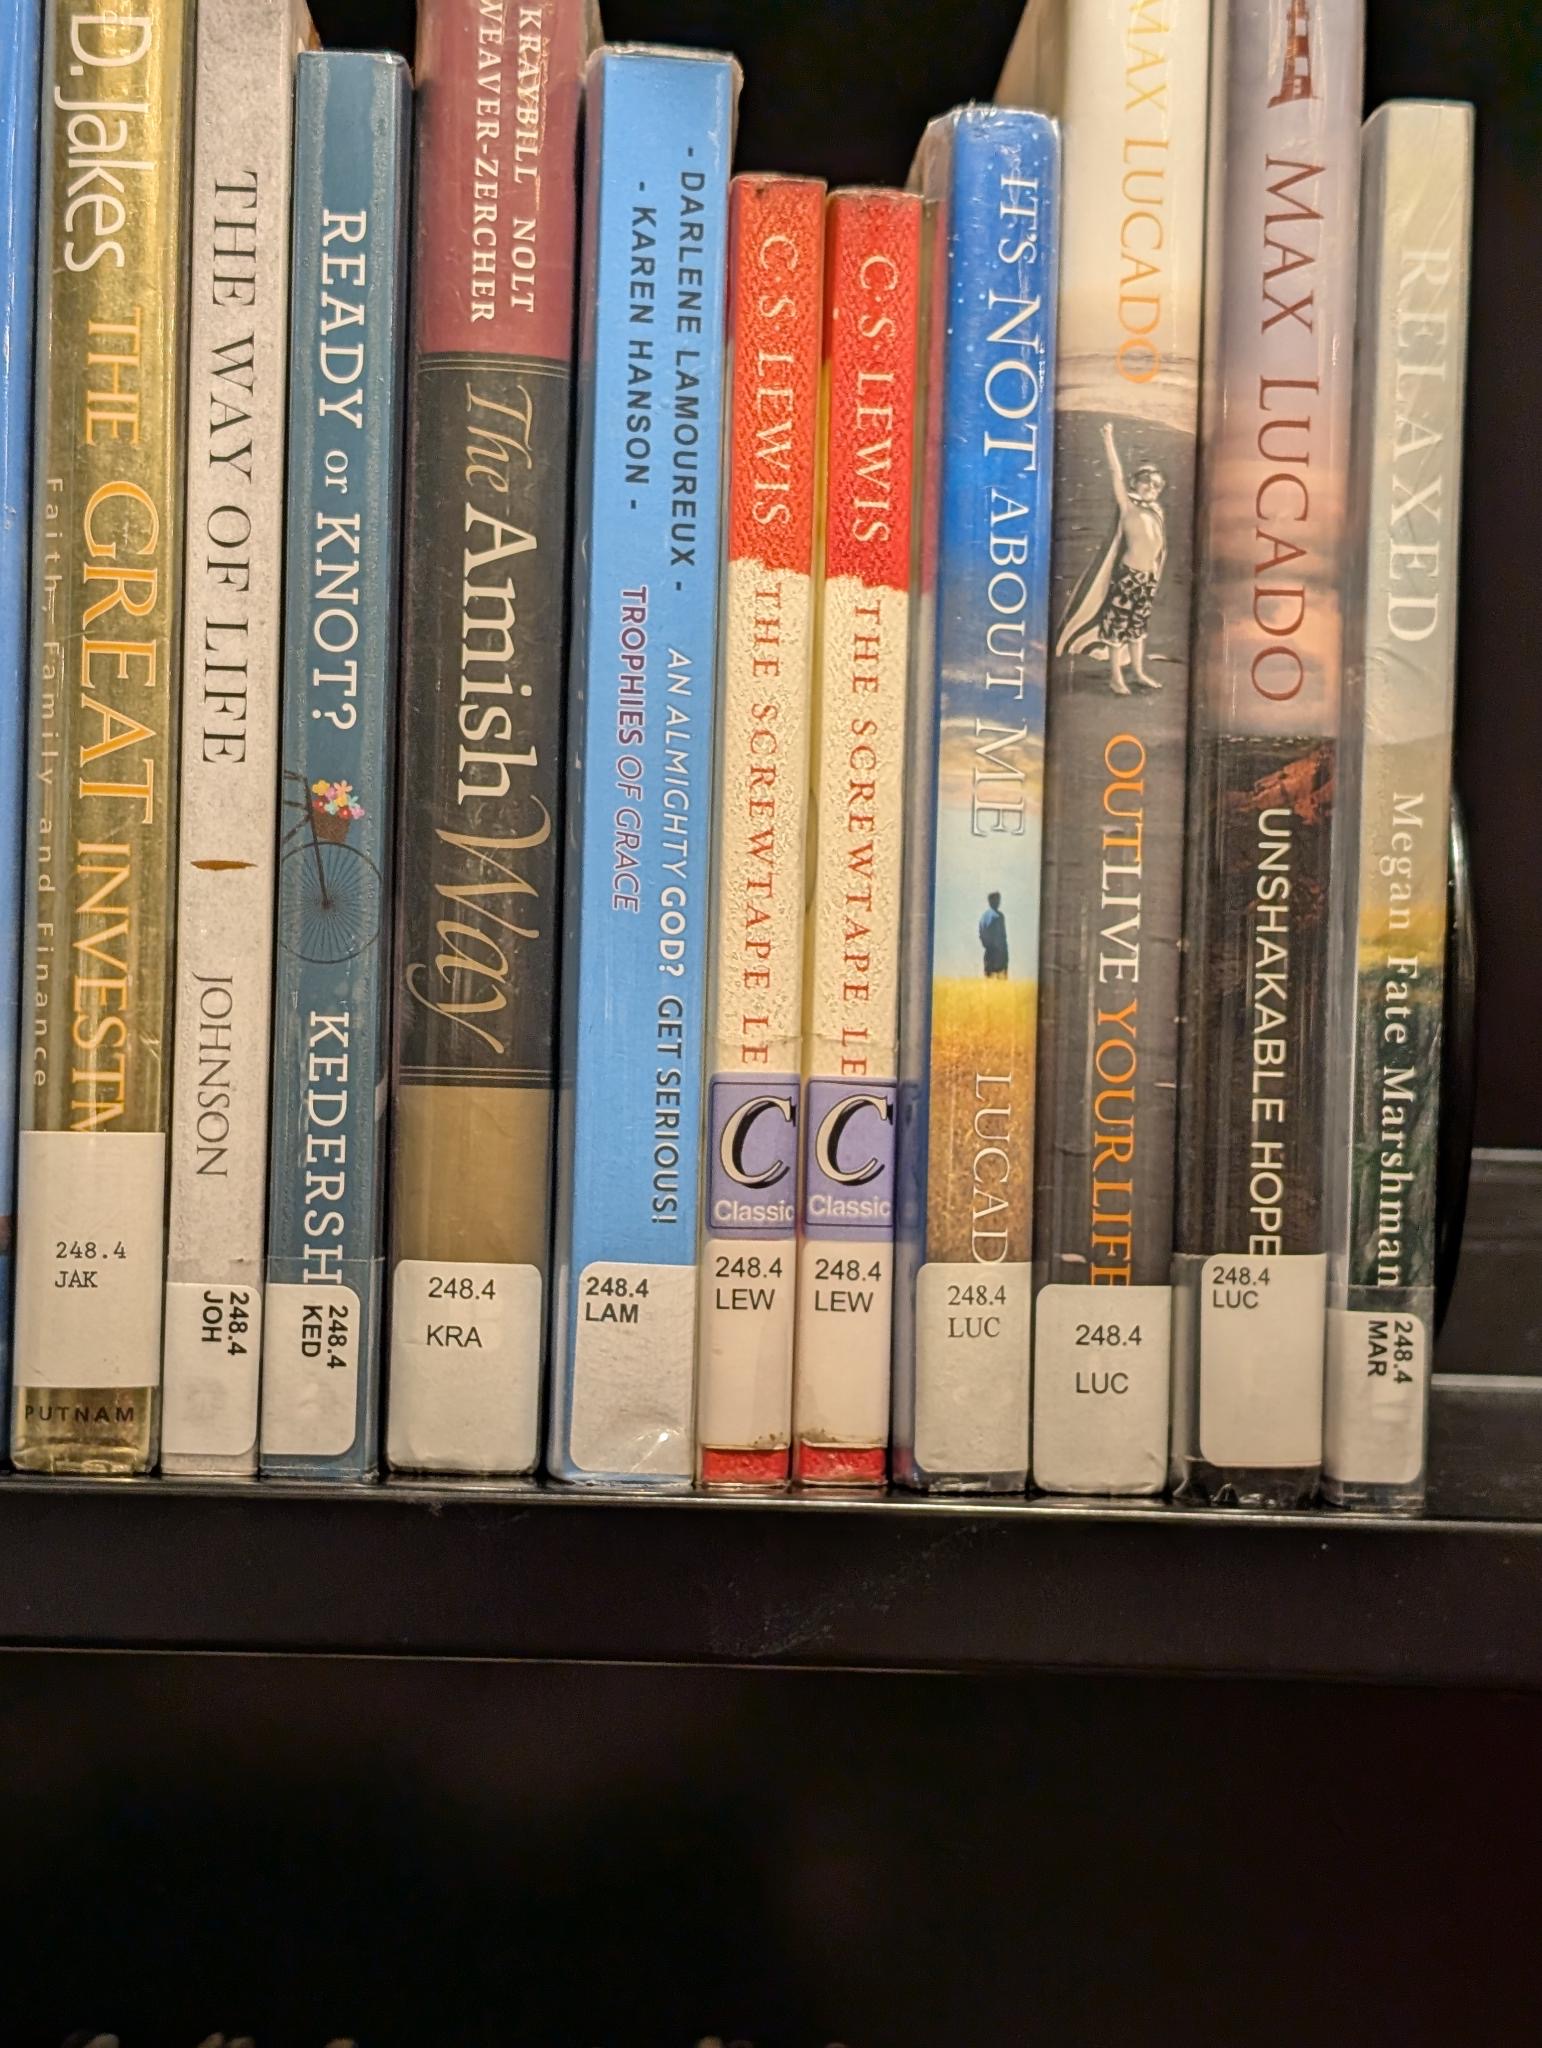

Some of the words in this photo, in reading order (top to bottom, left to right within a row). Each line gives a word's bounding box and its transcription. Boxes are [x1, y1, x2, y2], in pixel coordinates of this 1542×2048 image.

[70, 15, 152, 76] D.
[514, 8, 542, 184] KRAYBILL
[1124, 0, 1169, 112] MAX
[54, 86, 156, 273] Jakes
[471, 0, 504, 322] WEAVER-ZERCHER
[213, 170, 258, 306] THE
[510, 218, 537, 312] NOLT
[629, 208, 657, 324] KAREN
[675, 171, 705, 333] DARLENE
[1115, 137, 1170, 384] LUCADO
[1261, 154, 1327, 335] MAX
[319, 208, 367, 429] READY
[86, 307, 141, 446] THE
[209, 332, 254, 483] WAY
[625, 340, 654, 484] HANSON
[983, 289, 1041, 471] NOT
[324, 450, 349, 494] or
[465, 383, 533, 492] The
[671, 349, 703, 567] LAMOUREUX
[1385, 247, 1451, 642] RELAXED
[206, 505, 252, 592] OF
[1251, 375, 1320, 701] LUCADO
[312, 512, 361, 730] KNOT?
[752, 583, 783, 678] THE
[851, 600, 883, 694] THE
[986, 489, 1029, 700] ABOUT
[79, 481, 159, 825] GREAT
[202, 616, 249, 763] LIFE
[457, 502, 537, 805] Amish
[617, 586, 649, 746] TROPHIES
[666, 648, 692, 696] AN
[37, 642, 60, 786] Family
[616, 756, 644, 802] OF
[661, 705, 691, 879] ALMIGHTY
[972, 718, 1028, 837] ME
[38, 817, 56, 891] and
[612, 808, 642, 914] GRACE
[743, 702, 779, 990] SCREWTAPE
[841, 719, 877, 1003] SCREWTAPE
[1098, 733, 1147, 984] OUTLIVE
[1380, 792, 1424, 931] Megan
[406, 795, 551, 1054] Way
[658, 886, 686, 977] GOD?
[1251, 808, 1292, 1123] UNSHAKABLE
[33, 923, 55, 1086] Finance
[657, 997, 683, 1060] GET
[741, 1015, 771, 1065] LE
[841, 1027, 869, 1076] LE
[1384, 955, 1419, 1044] Fate
[192, 975, 233, 1178] JOHNSON
[1092, 1001, 1137, 1172] YOUR
[303, 1010, 350, 1285] KEDERSH
[652, 1069, 682, 1225] SERIOUS!
[720, 1095, 796, 1188] C
[815, 1093, 893, 1186] C
[971, 1072, 1013, 1264] LUCAD
[1377, 1067, 1418, 1288] Marshman
[55, 1241, 127, 1260] 248.4
[808, 1195, 891, 1218] Classic
[1249, 1141, 1283, 1255] HOPE
[54, 1271, 98, 1289] JAK
[201, 1290, 223, 1343] JOH
[429, 1277, 496, 1300] 248.4
[585, 1303, 639, 1323] LAM
[586, 1278, 650, 1299] 248.4
[716, 1256, 782, 1278] 248.4
[716, 1288, 775, 1310] LEW
[814, 1290, 874, 1313] LEW
[815, 1258, 882, 1281] 248.4
[947, 1285, 1006, 1306] 248.4
[1212, 1266, 1270, 1285] 248.4
[1212, 1290, 1259, 1309] LUC
[227, 1291, 250, 1356] 248.4
[301, 1305, 323, 1358] KED
[326, 1304, 349, 1369] 248.4
[426, 1325, 482, 1348] KRA
[948, 1317, 1001, 1338] LUC
[1075, 1324, 1142, 1346] 248.4
[1367, 1320, 1389, 1377] MAR
[1393, 1320, 1414, 1385] 248.4
[25, 1406, 135, 1422] PUTNAM
[1075, 1372, 1129, 1394] LUC
